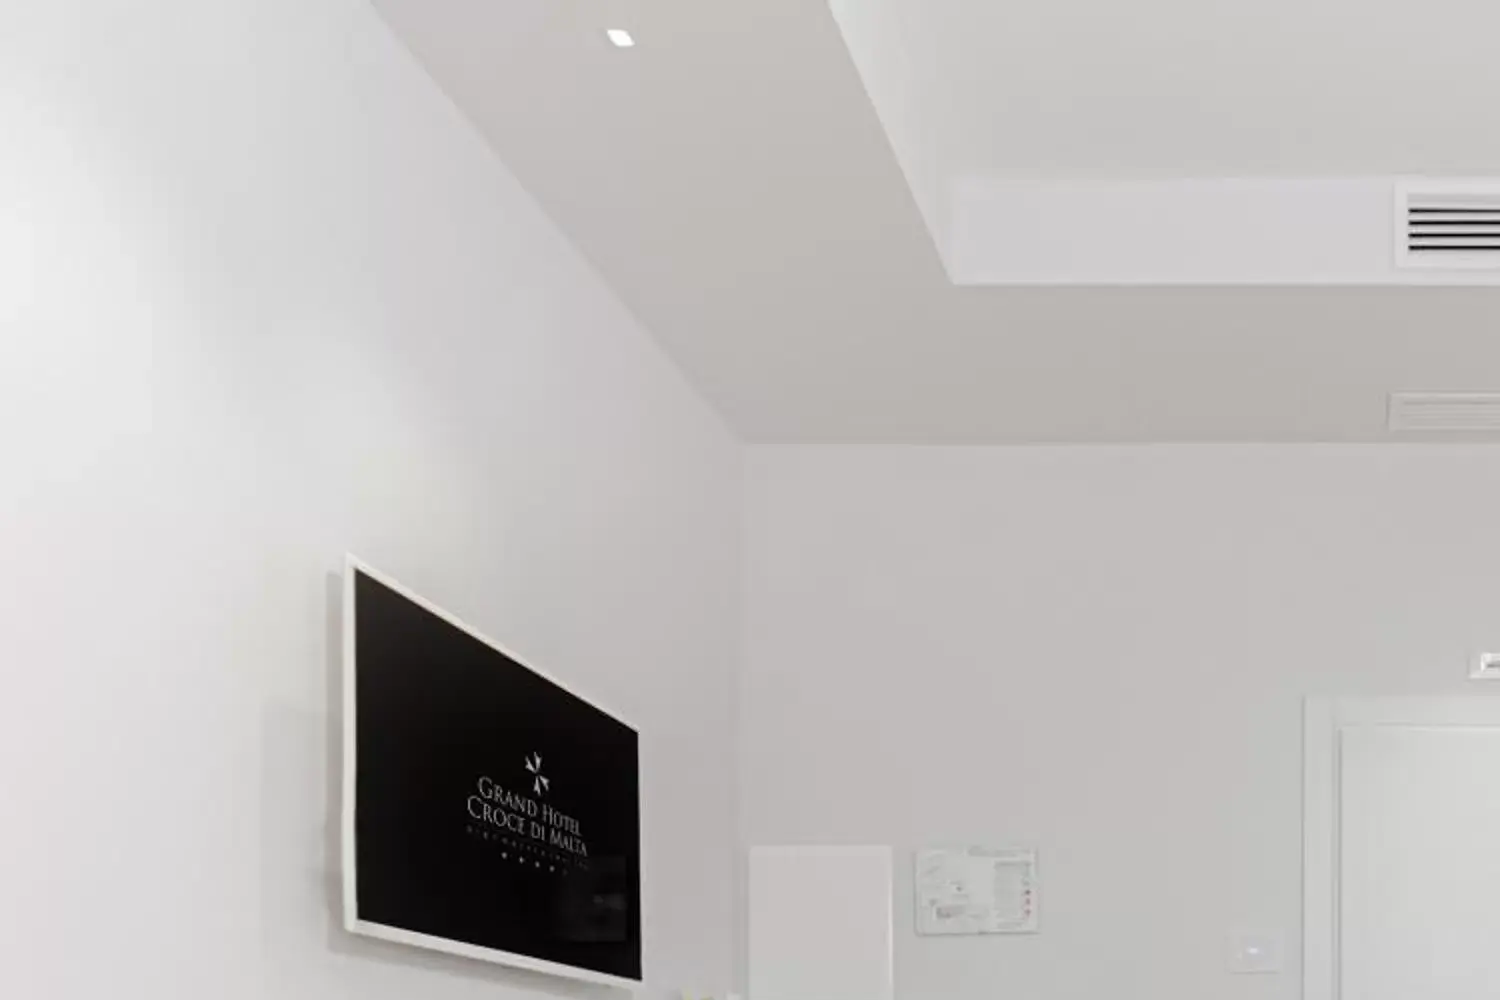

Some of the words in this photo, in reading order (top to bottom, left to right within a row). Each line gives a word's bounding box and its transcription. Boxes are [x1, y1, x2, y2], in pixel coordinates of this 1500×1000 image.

[467, 794, 526, 835] CROCE
[530, 820, 546, 842] DI
[549, 827, 588, 857] MALTA
[477, 776, 538, 817] GRAND
[542, 803, 582, 837] HOTEL
